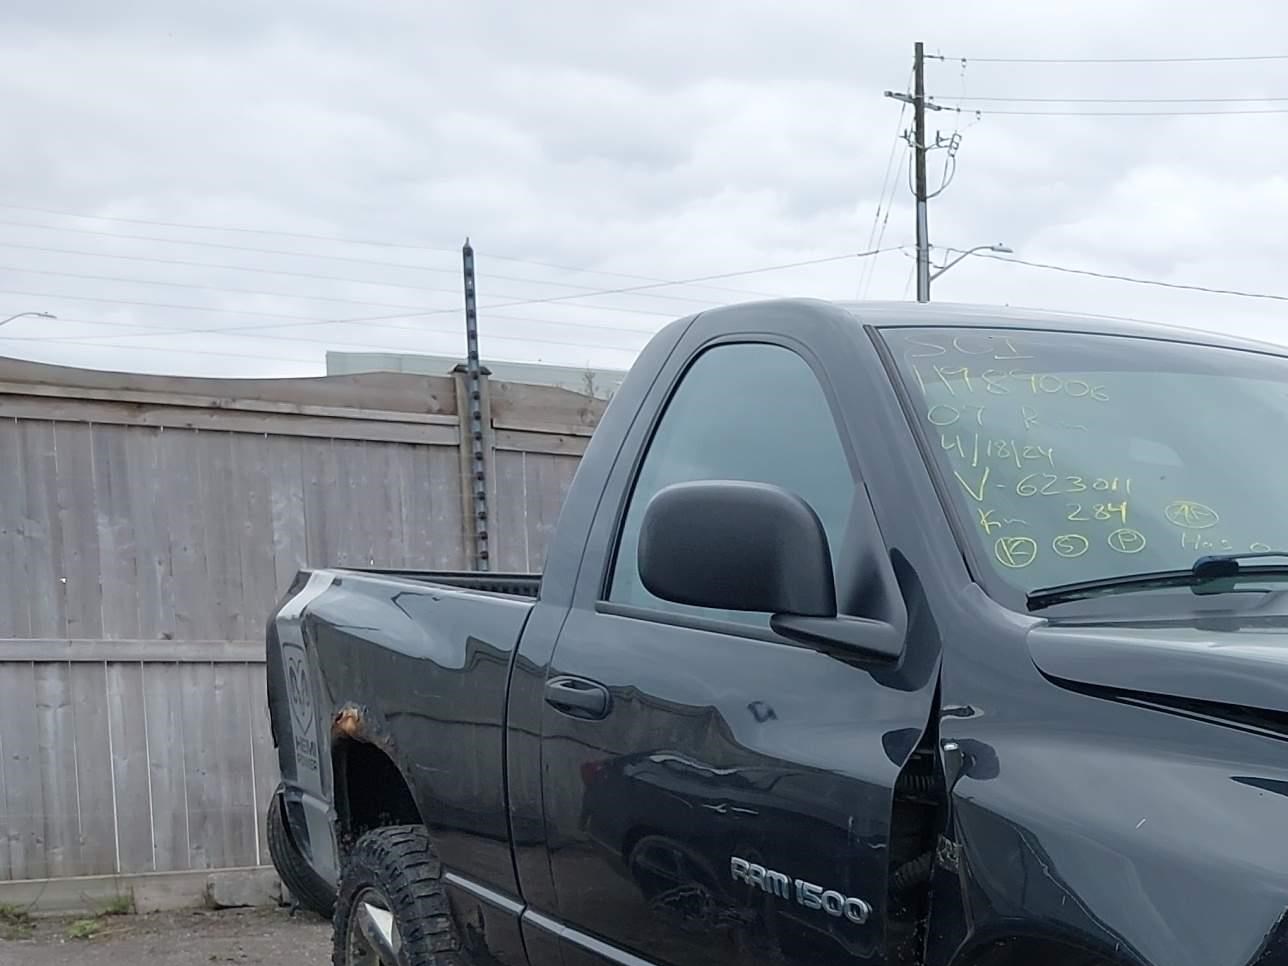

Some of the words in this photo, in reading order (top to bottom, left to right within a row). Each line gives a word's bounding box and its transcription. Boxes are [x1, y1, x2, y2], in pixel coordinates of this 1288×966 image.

[940, 433, 1054, 469] 4/18/24
[1066, 500, 1129, 527] 284
[730, 856, 791, 900] RAM
[795, 879, 873, 925] 1500
